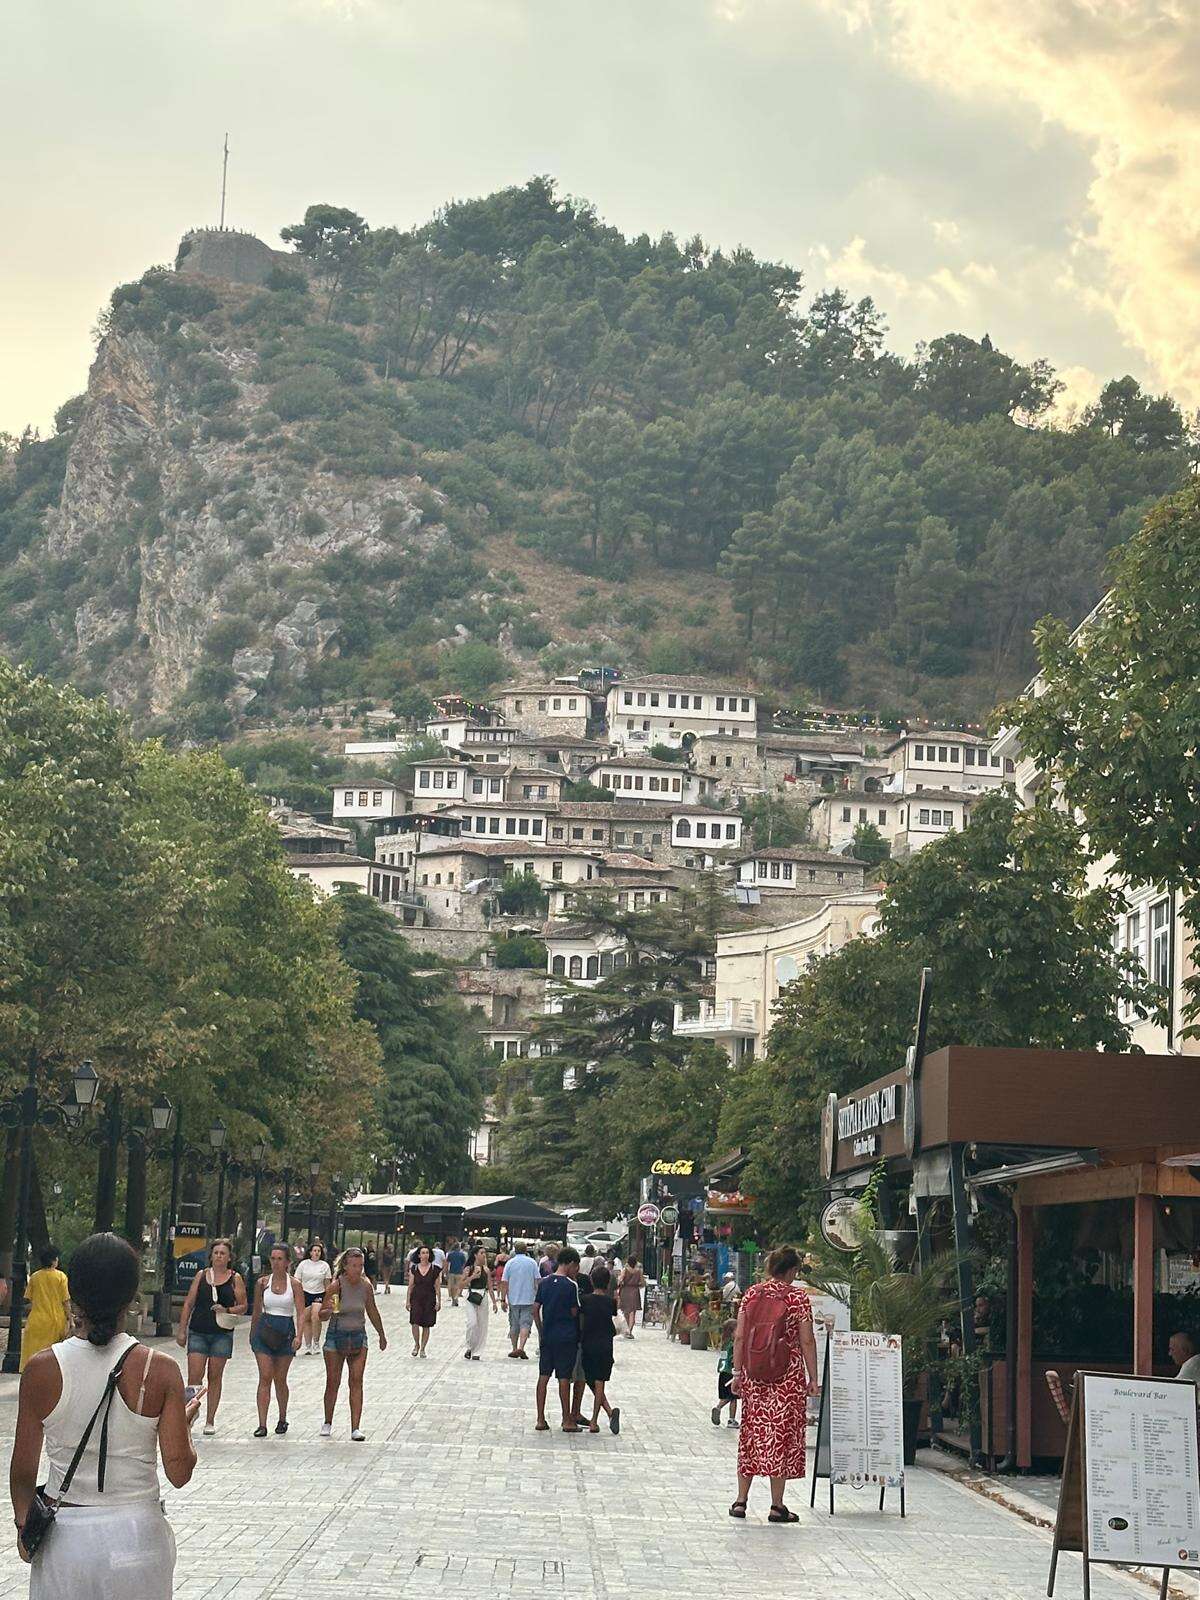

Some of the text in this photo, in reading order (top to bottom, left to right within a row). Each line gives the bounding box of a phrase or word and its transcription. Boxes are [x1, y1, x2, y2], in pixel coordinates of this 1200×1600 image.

[181, 1227, 200, 1235] ATM
[179, 1261, 198, 1269] ATM
[851, 1338, 880, 1347] MENU
[1113, 1388, 1168, 1400] Boulevard Bar
